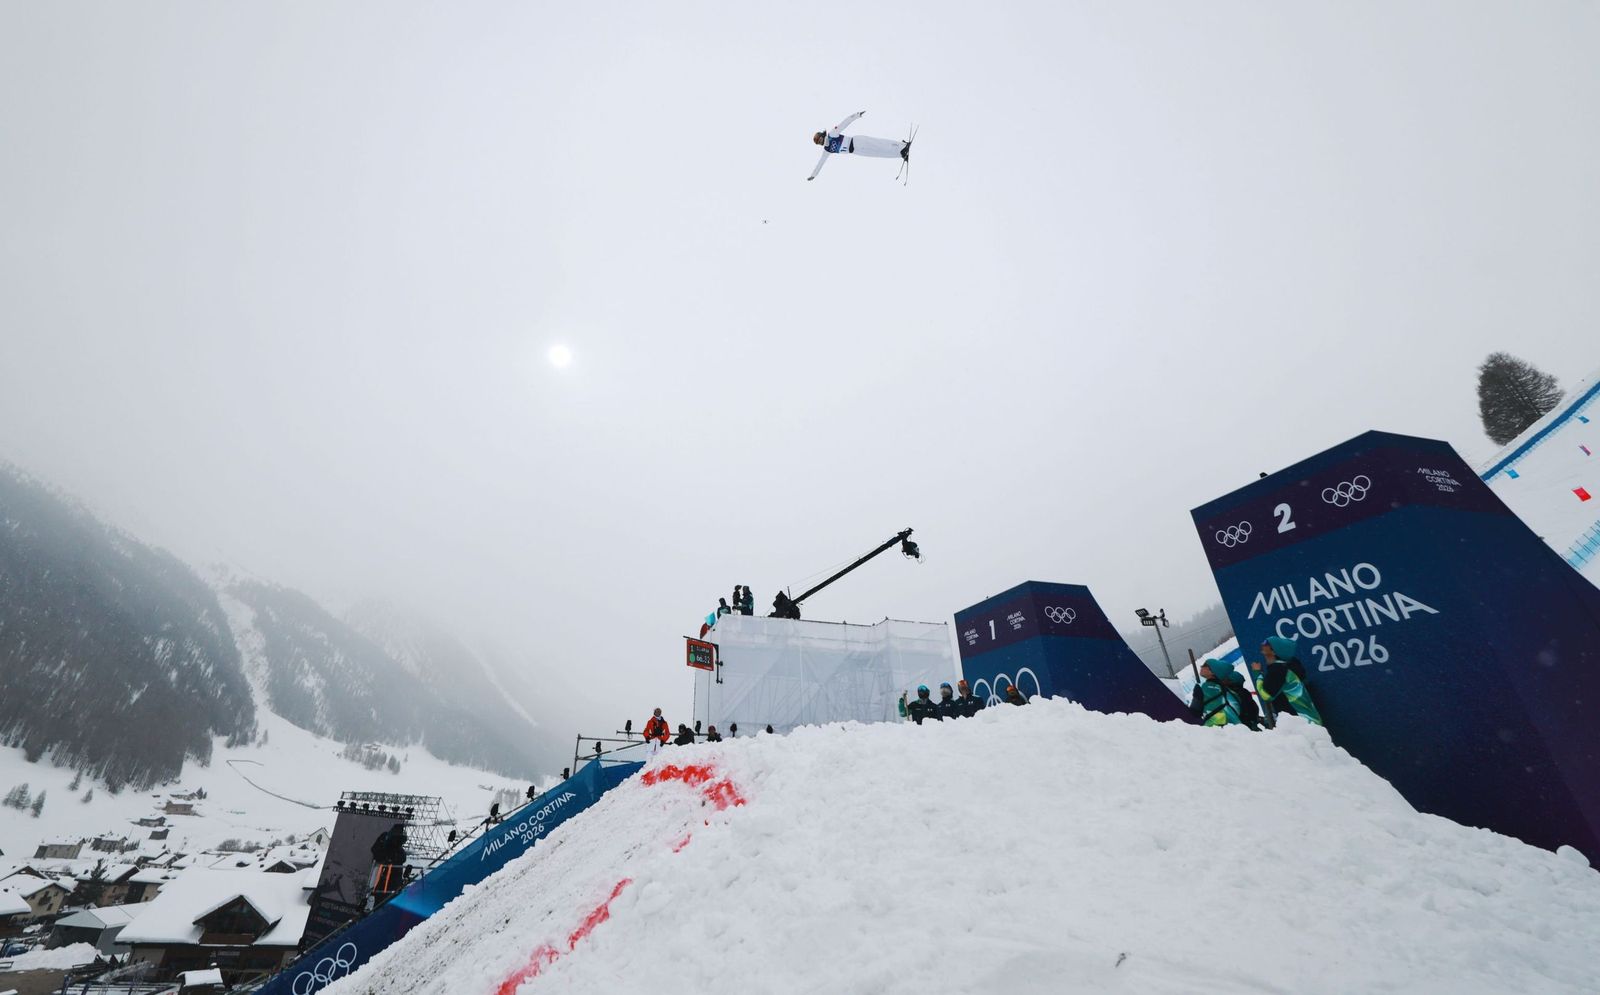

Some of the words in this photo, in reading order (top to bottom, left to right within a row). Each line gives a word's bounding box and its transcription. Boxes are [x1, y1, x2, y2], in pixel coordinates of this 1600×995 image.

[1273, 503, 1296, 534] 2
[1248, 562, 1381, 619] MILANO
[989, 620, 996, 640] 1
[1275, 591, 1440, 641] CORTINA
[1311, 635, 1389, 672] 2026
[481, 822, 528, 861] MILANO
[528, 792, 577, 826] CORTINA
[520, 823, 545, 845] 2026
